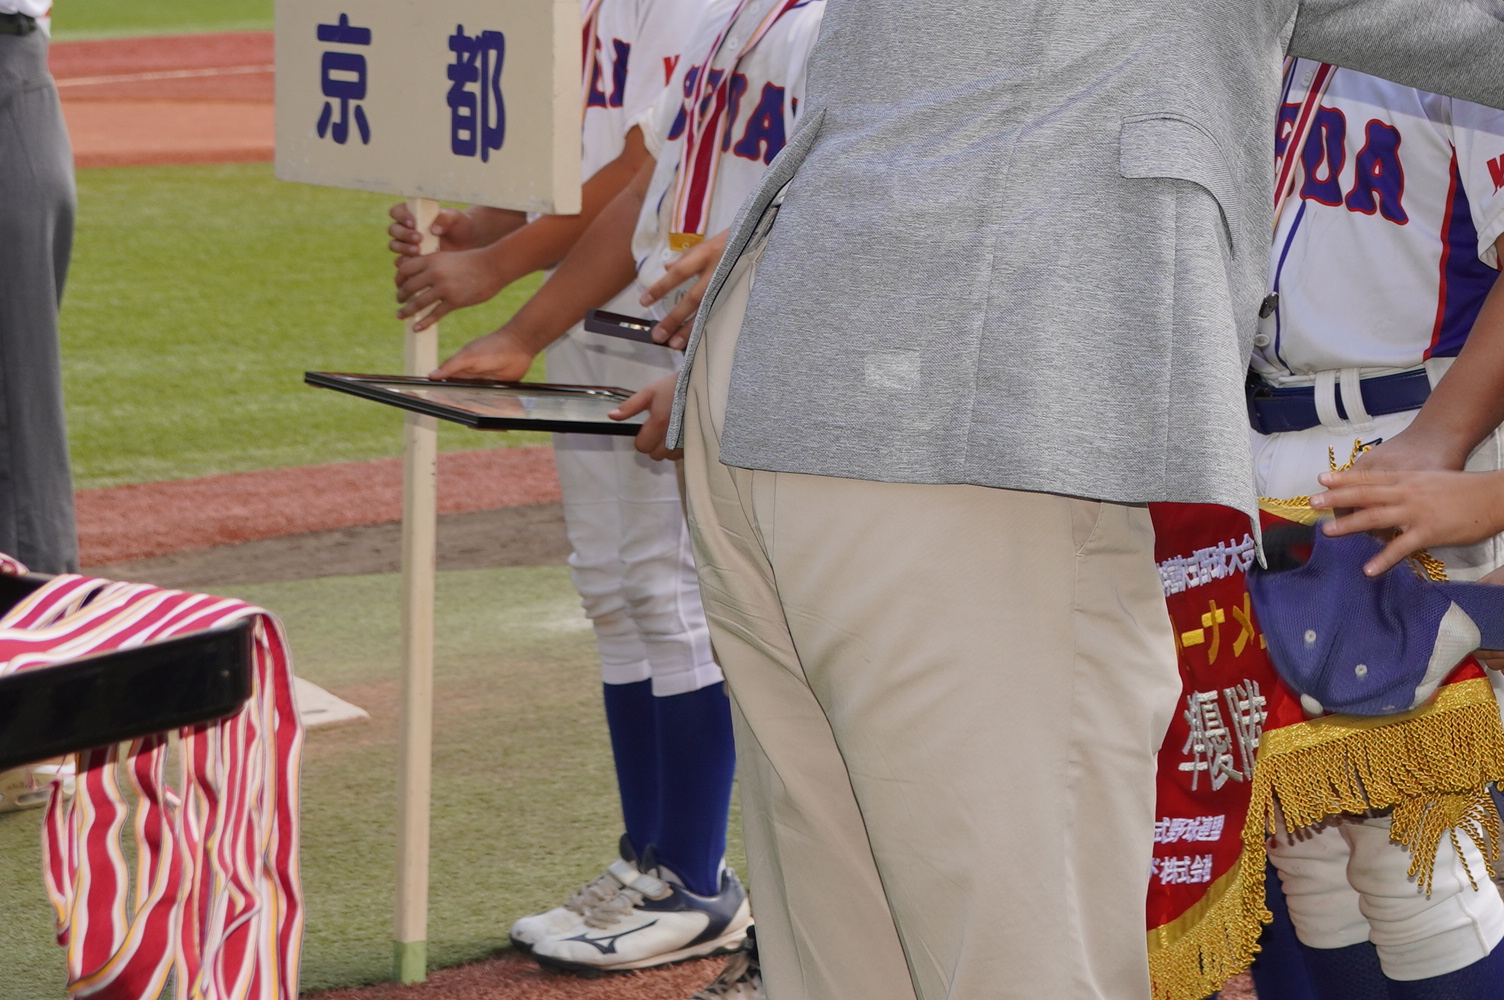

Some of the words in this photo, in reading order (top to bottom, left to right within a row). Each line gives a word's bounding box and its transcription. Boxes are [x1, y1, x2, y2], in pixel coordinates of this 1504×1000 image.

[316, 12, 507, 164] 京都
[1170, 591, 1268, 672] ーナメ
